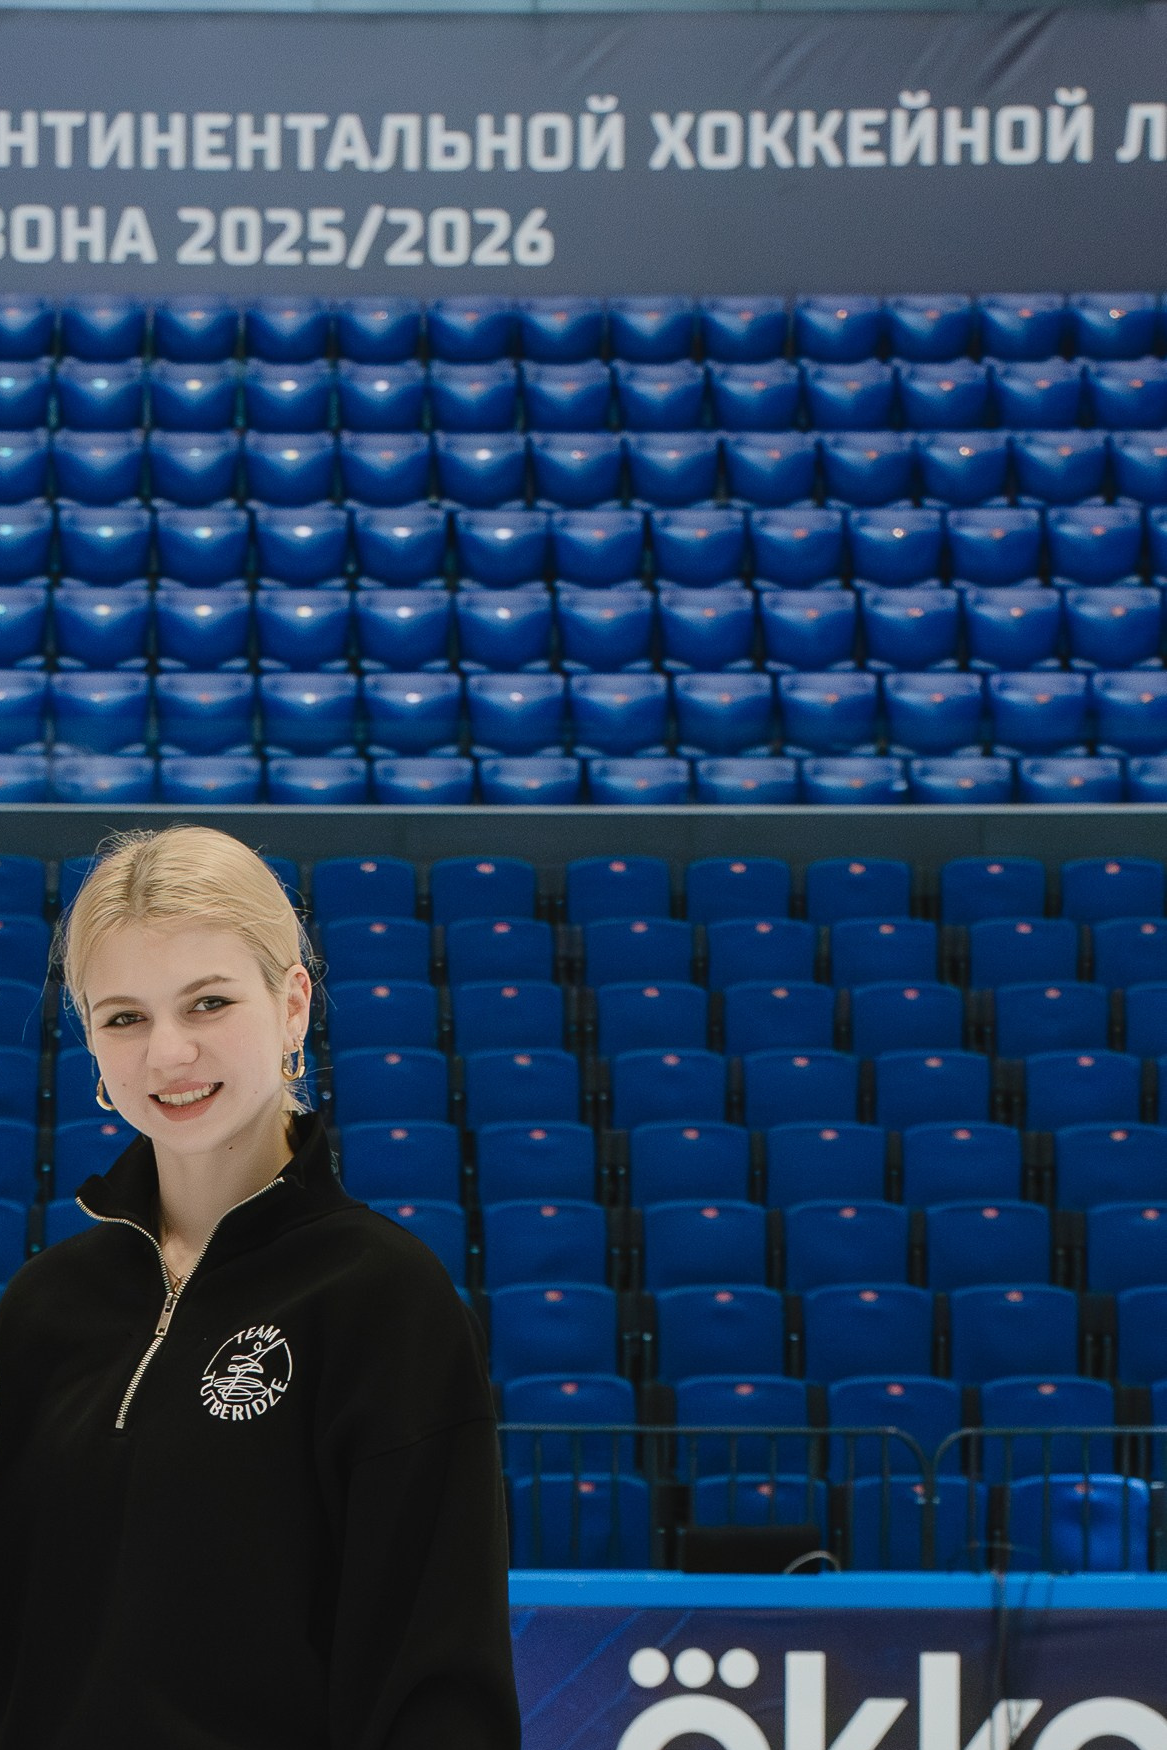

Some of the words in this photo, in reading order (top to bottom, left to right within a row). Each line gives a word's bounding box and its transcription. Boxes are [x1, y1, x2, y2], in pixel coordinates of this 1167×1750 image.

[649, 87, 1094, 170] ХОККЕЙНОЙ
[176, 205, 555, 269] 2025/2026
[236, 1325, 280, 1344] TEAM
[200, 1371, 288, 1421] TUTBERIDZE
